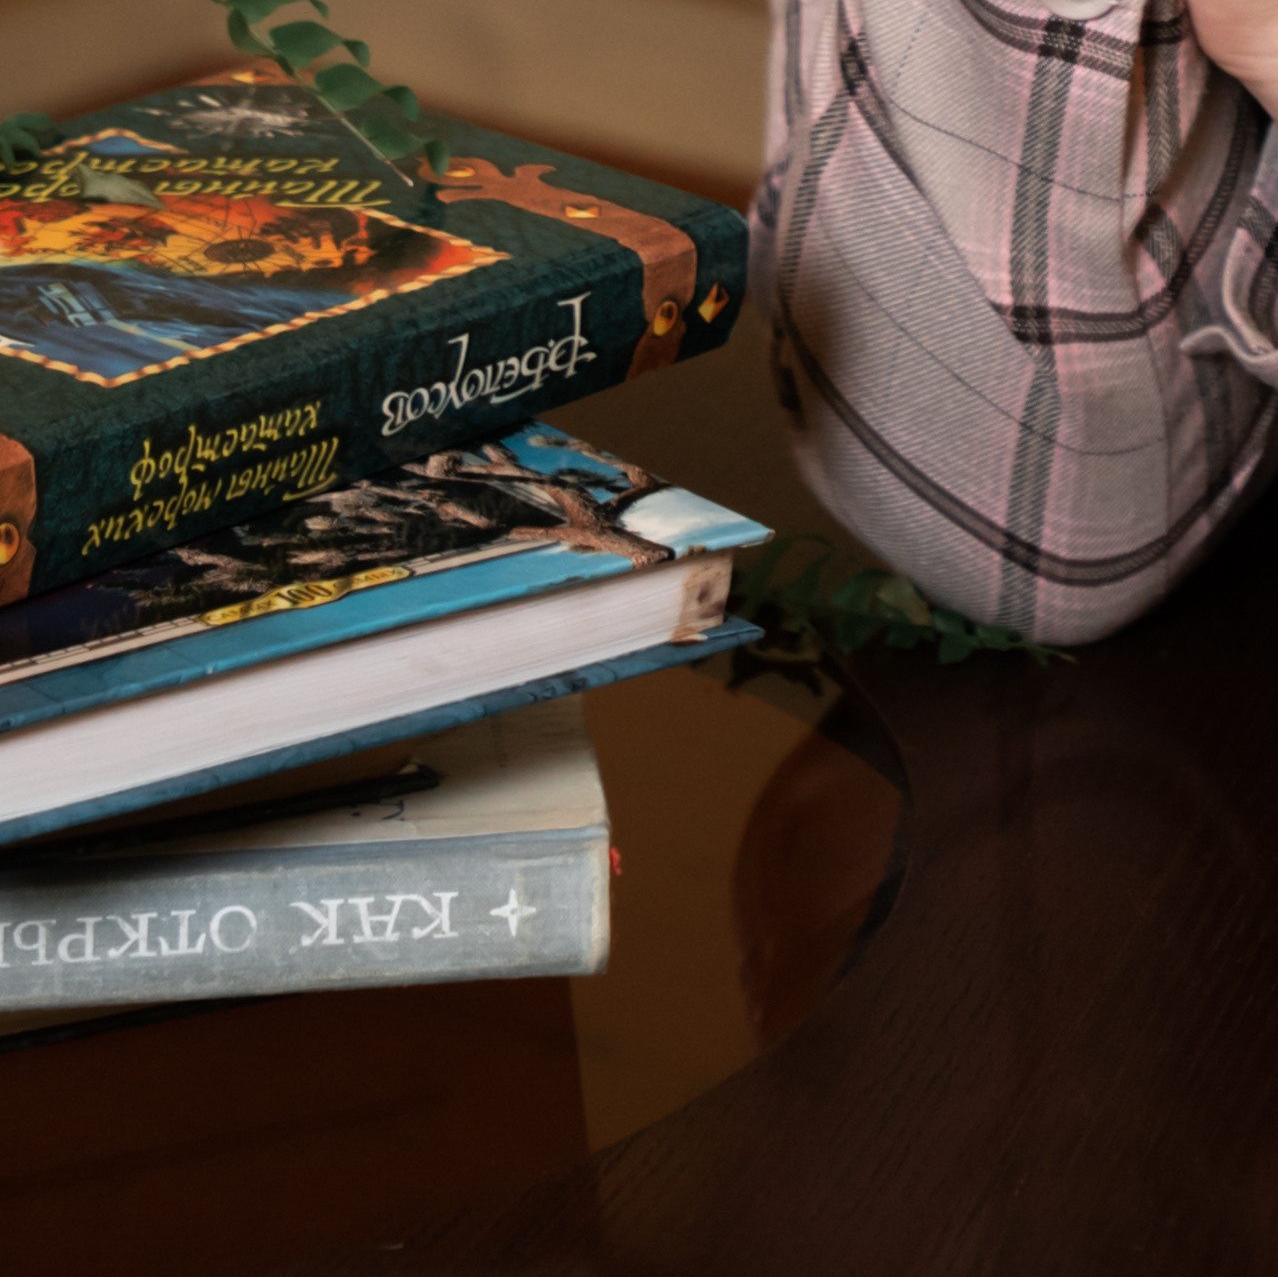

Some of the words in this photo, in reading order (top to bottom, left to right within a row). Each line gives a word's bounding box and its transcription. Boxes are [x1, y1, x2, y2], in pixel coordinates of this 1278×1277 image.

[0, 151, 340, 176] катастро
[155, 179, 391, 208] Тайны
[130, 401, 322, 500] катастроф
[226, 438, 339, 502] Тайны
[82, 469, 223, 555] морских
[276, 583, 332, 606] 100
[290, 891, 459, 947] КАК
